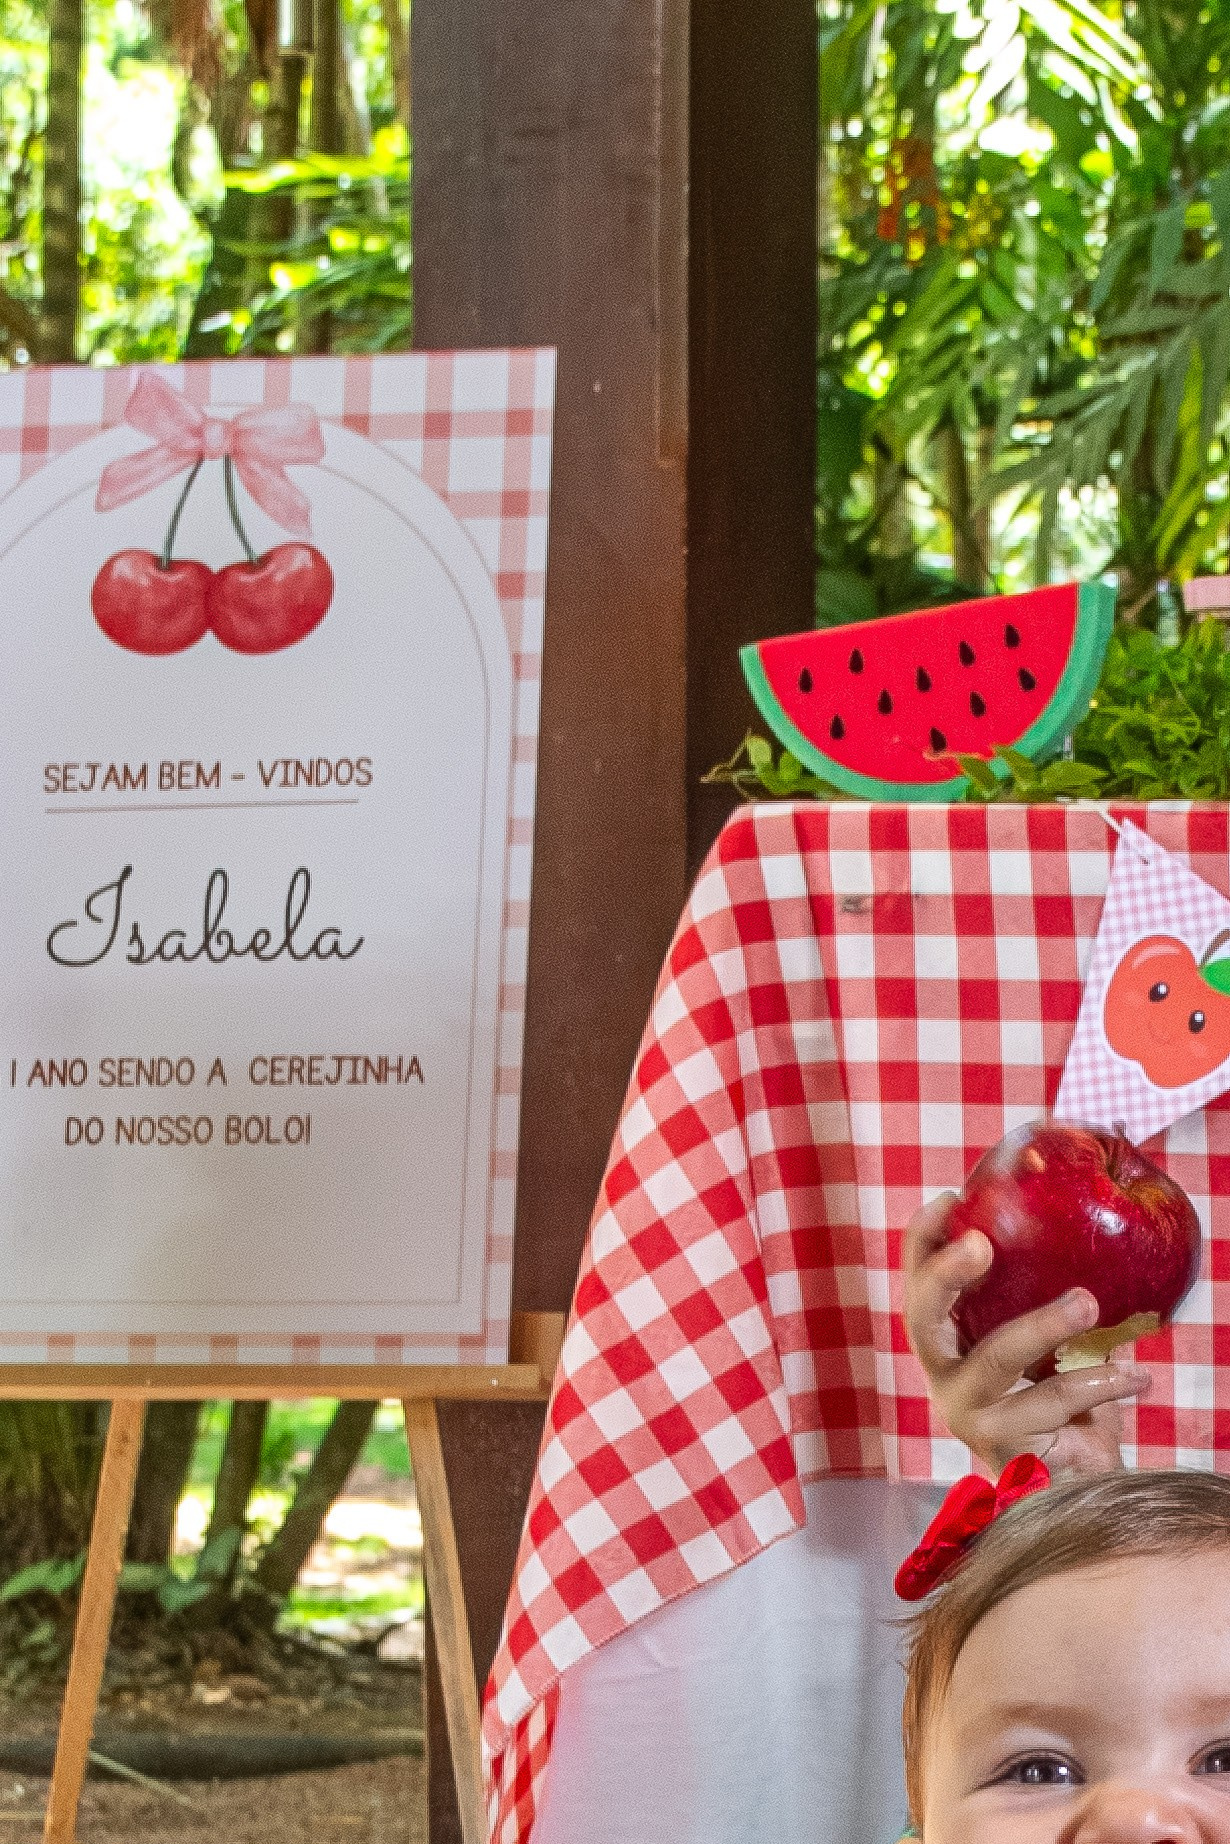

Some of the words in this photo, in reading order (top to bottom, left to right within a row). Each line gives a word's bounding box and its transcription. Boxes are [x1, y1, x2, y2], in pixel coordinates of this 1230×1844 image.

[43, 762, 149, 793] SEJAM
[158, 759, 222, 791] BEM
[257, 756, 374, 788] VINDOS
[46, 863, 365, 968] Isabela
[27, 1056, 89, 1087] ANO
[99, 1056, 196, 1088] SENDO
[206, 1056, 229, 1087] A
[249, 1055, 425, 1085] CEREJINHA
[64, 1115, 105, 1146] DO
[115, 1115, 214, 1146] NOSSO
